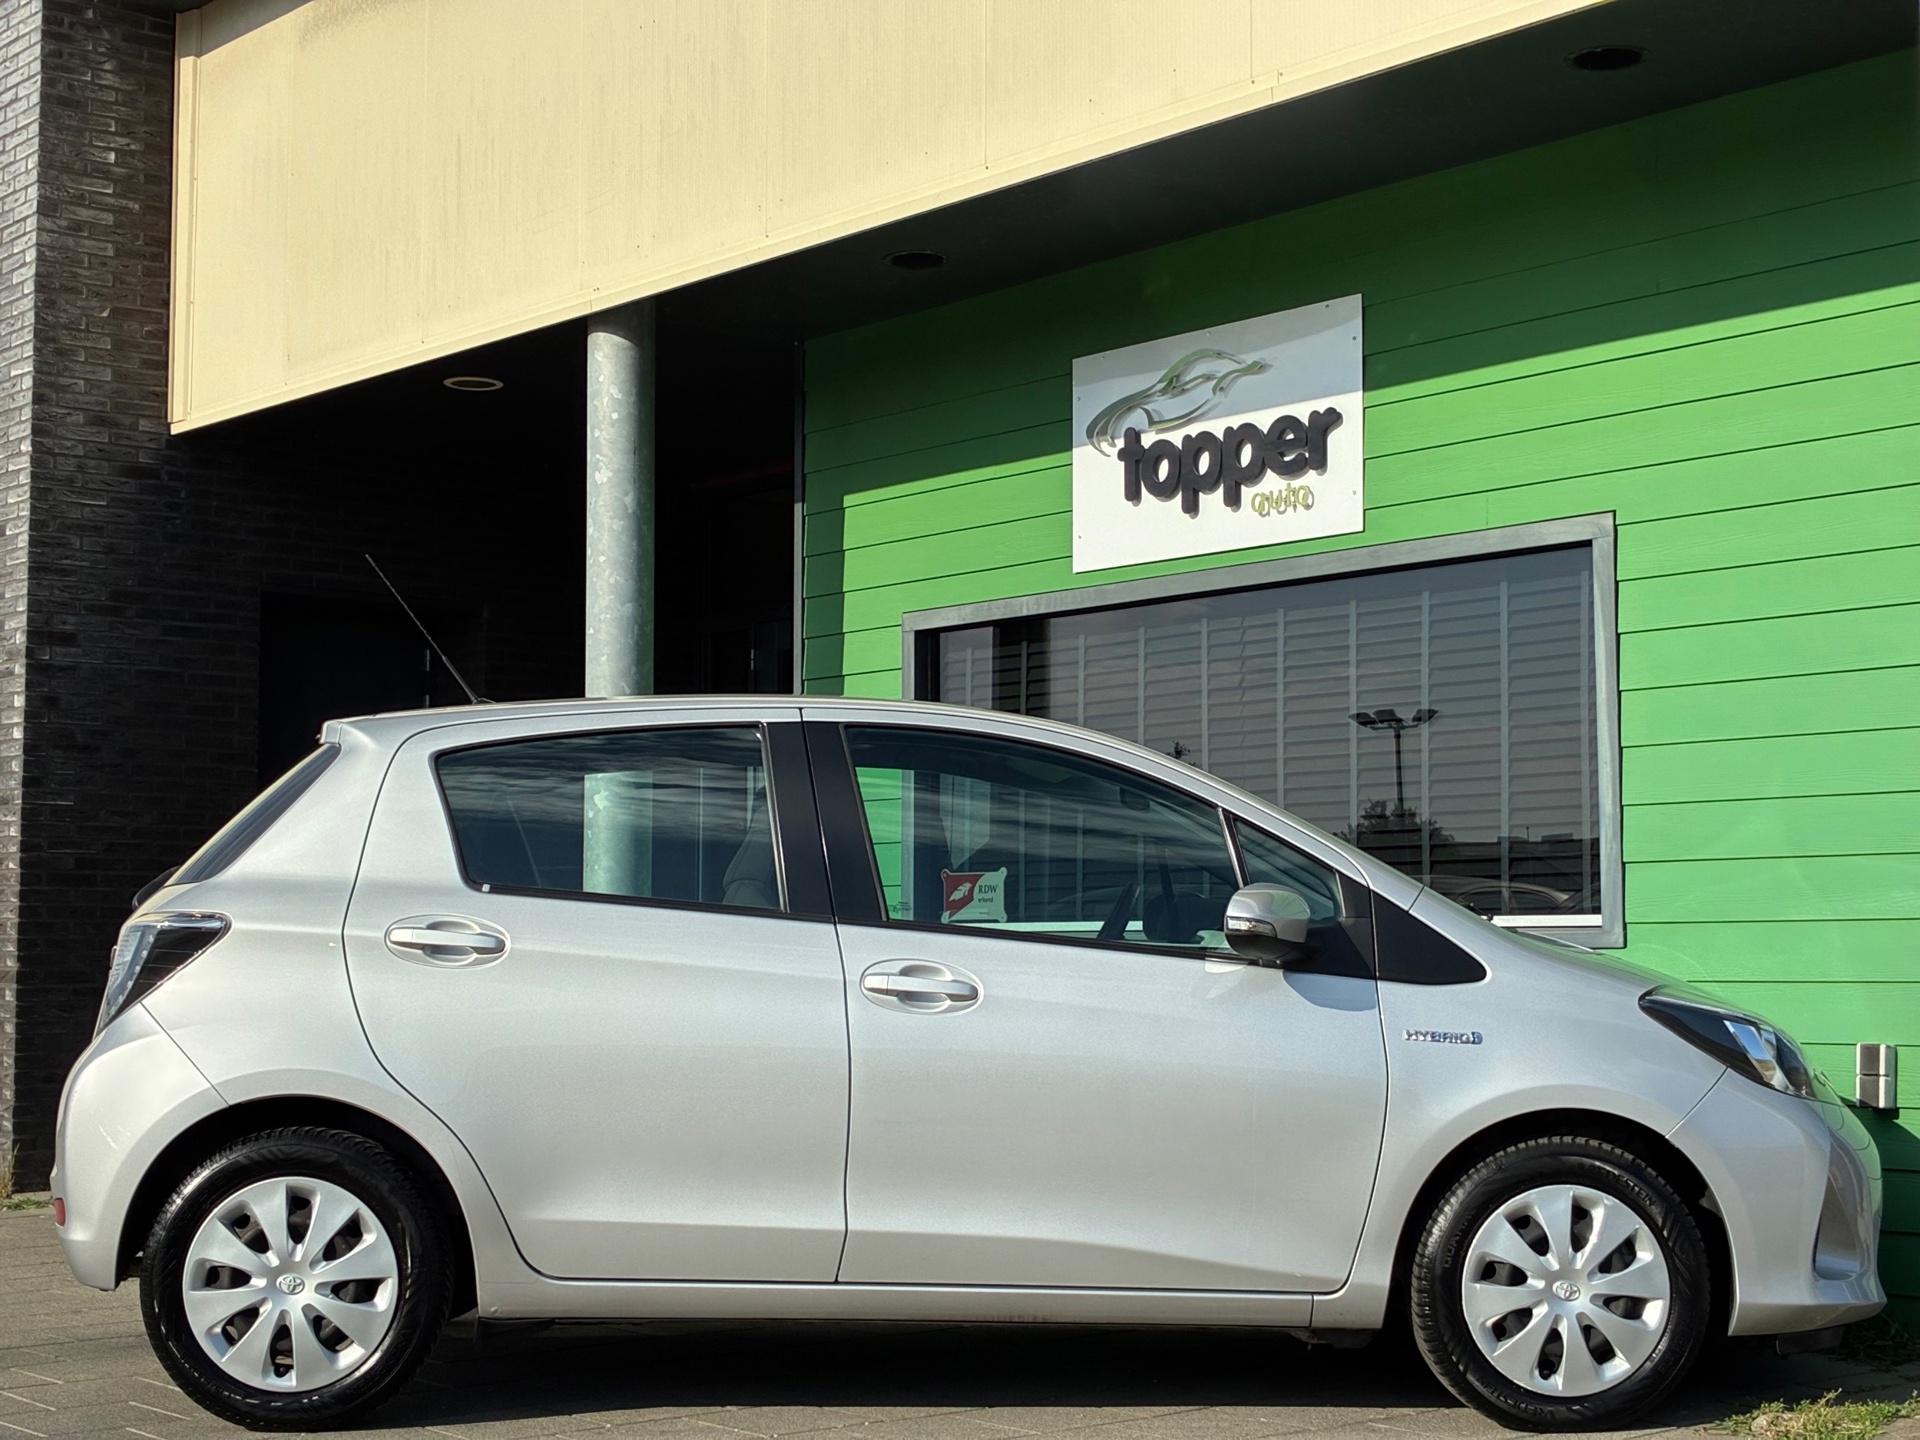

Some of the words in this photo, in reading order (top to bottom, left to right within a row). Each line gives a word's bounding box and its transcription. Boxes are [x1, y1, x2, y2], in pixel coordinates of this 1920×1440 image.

[1117, 407, 1343, 518] topper
[1251, 483, 1314, 517] auto
[978, 884, 998, 894] RDW
